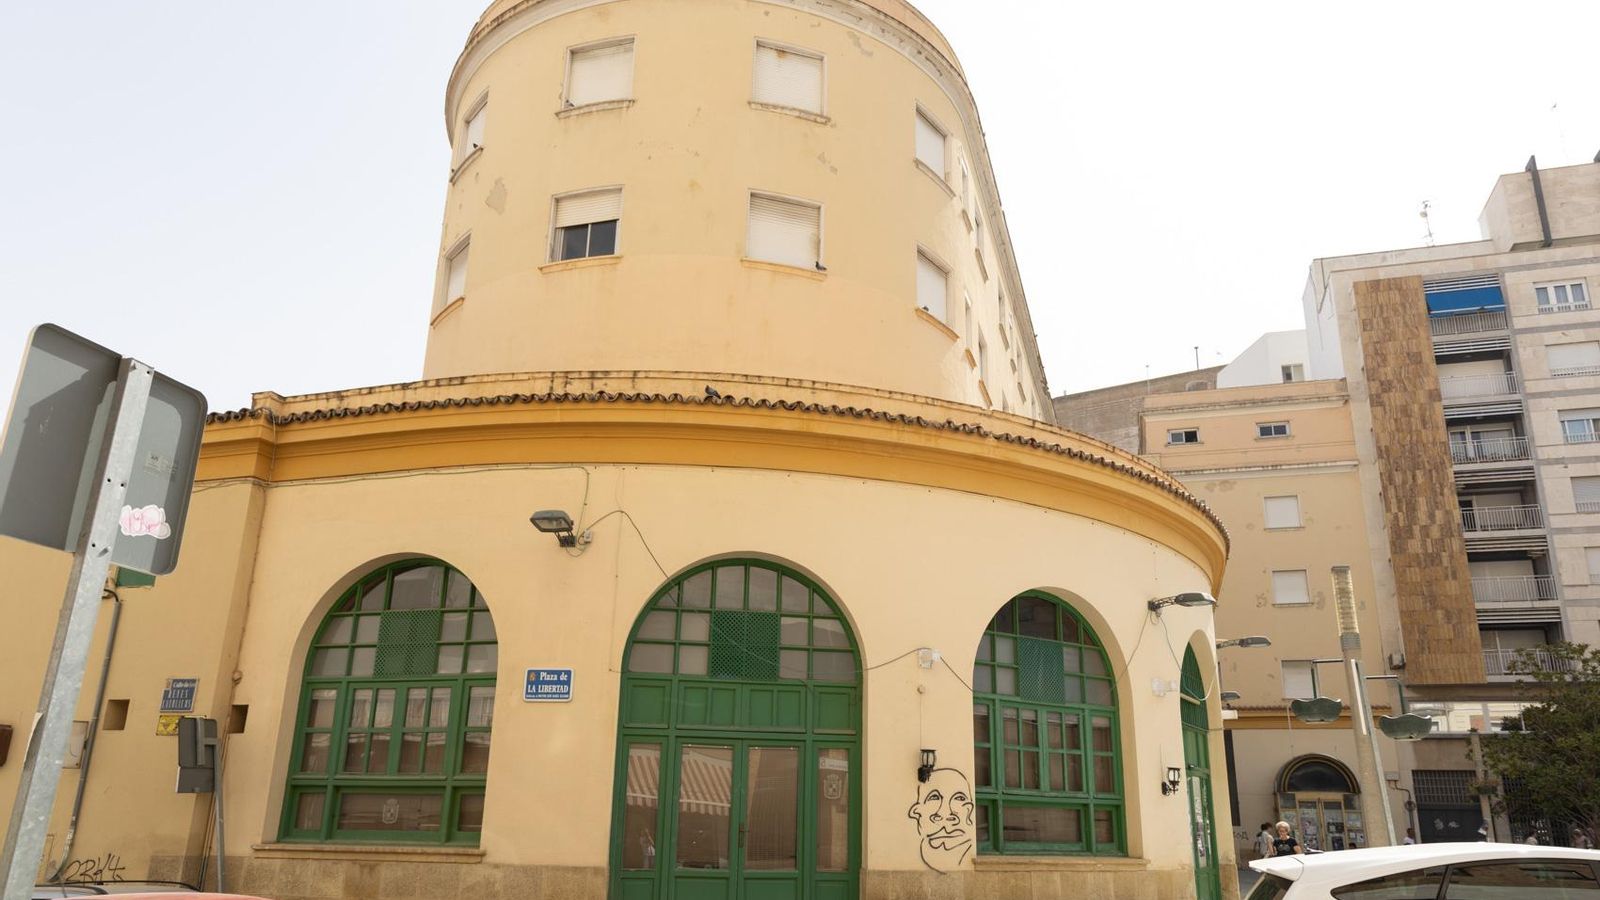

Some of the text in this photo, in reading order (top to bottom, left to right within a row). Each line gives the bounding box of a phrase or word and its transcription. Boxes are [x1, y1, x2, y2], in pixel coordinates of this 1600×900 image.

[540, 671, 568, 681] Plaza de
[528, 684, 569, 693] LA LIBERTAD
